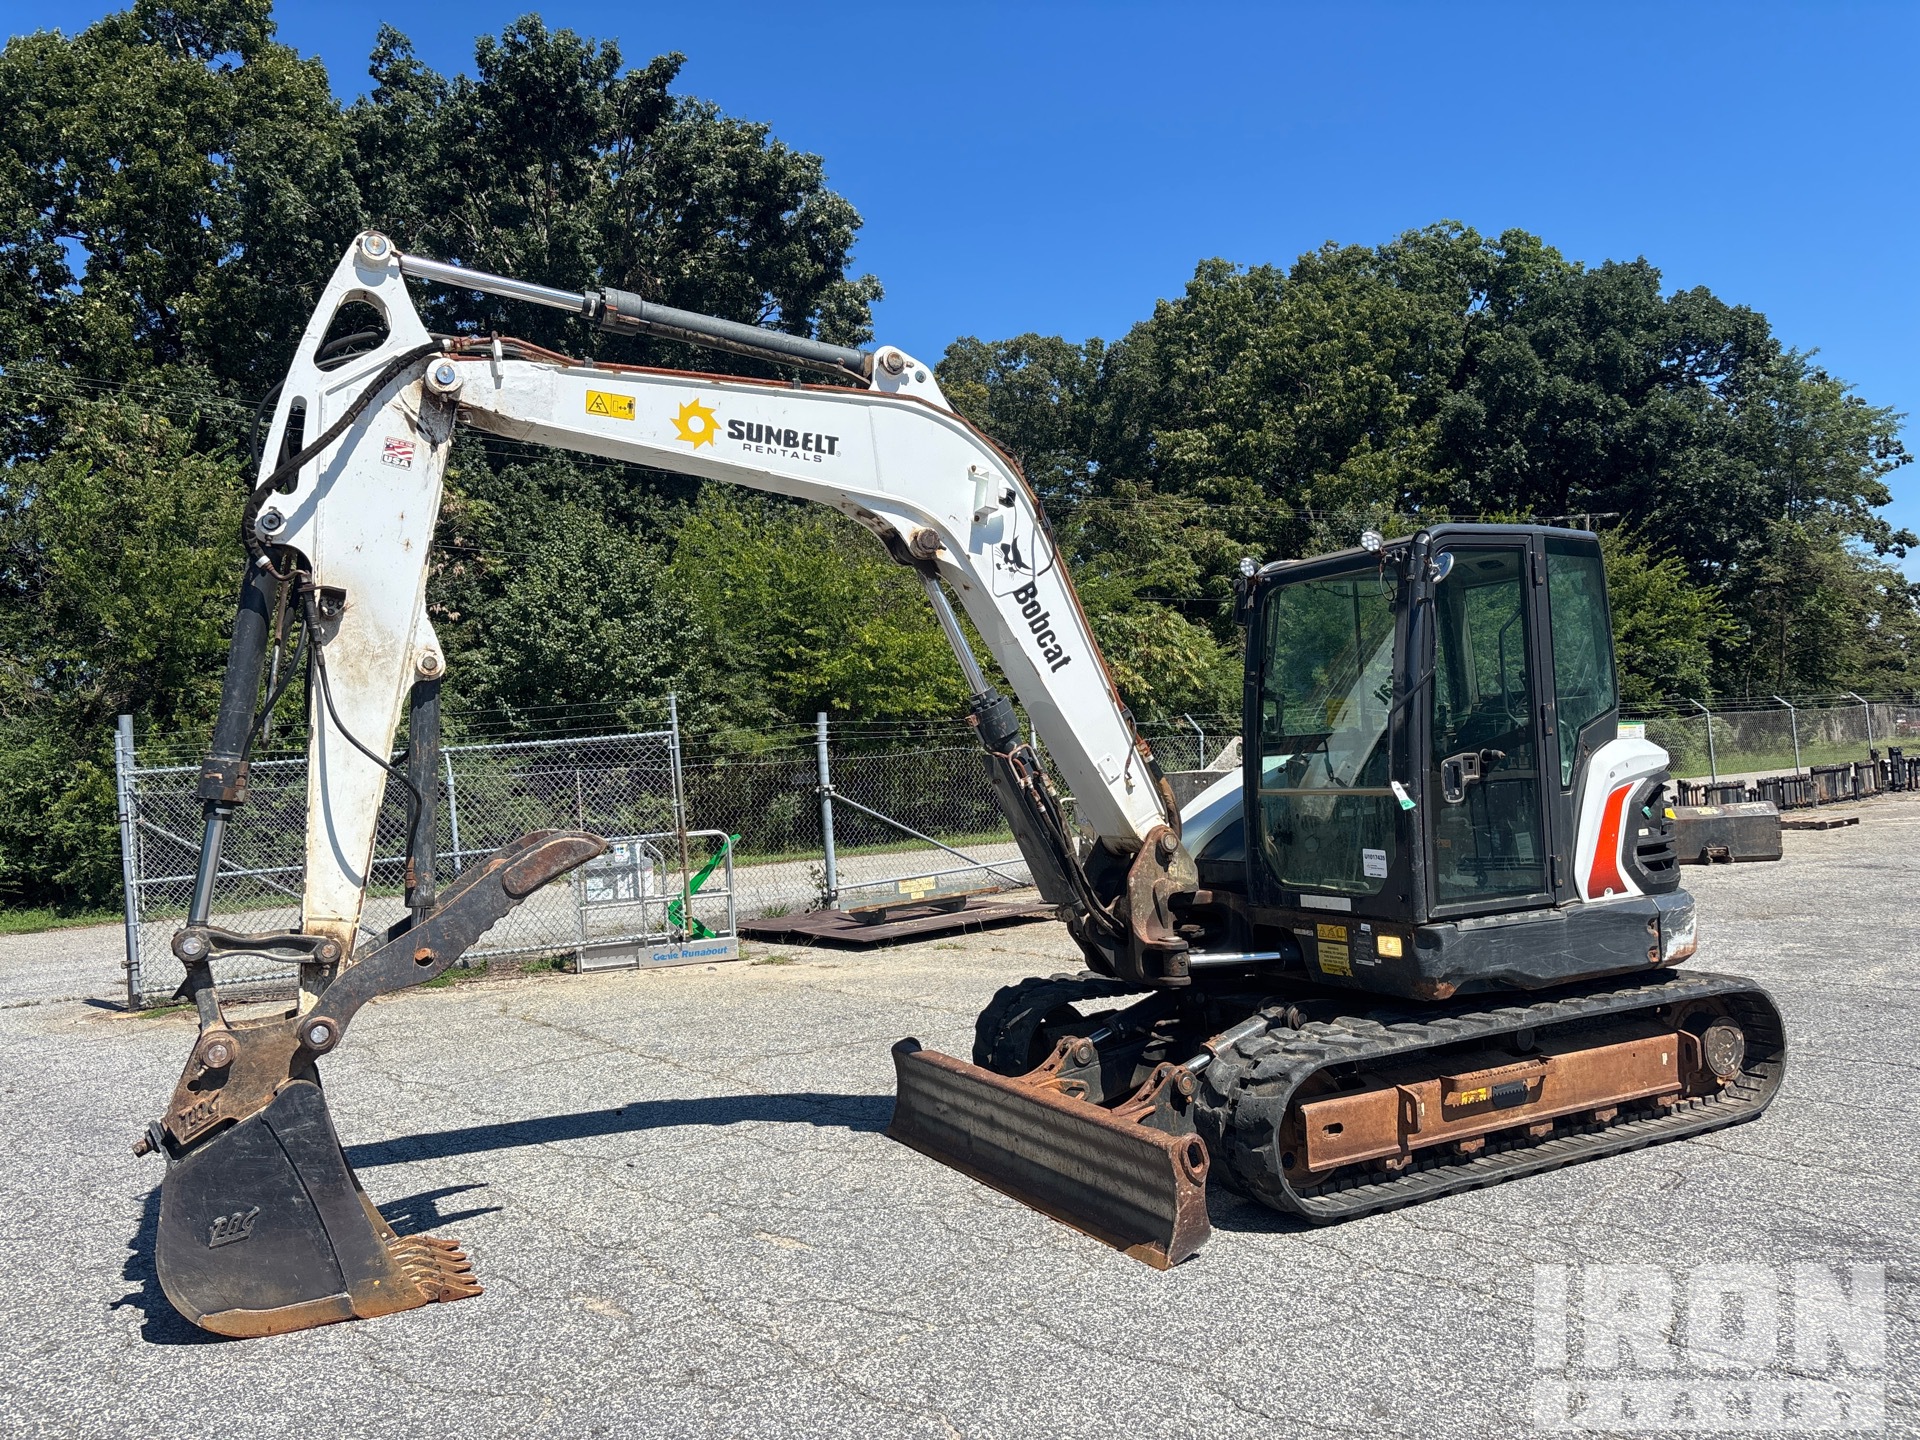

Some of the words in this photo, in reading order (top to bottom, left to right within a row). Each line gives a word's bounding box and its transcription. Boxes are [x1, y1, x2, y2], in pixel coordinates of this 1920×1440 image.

[728, 419, 839, 455] SUNBELT
[383, 455, 409, 467] USA
[743, 443, 822, 463] RENTALS
[1014, 581, 1072, 673] Bobcat
[653, 953, 678, 961] Genie
[682, 946, 727, 958] Runabout
